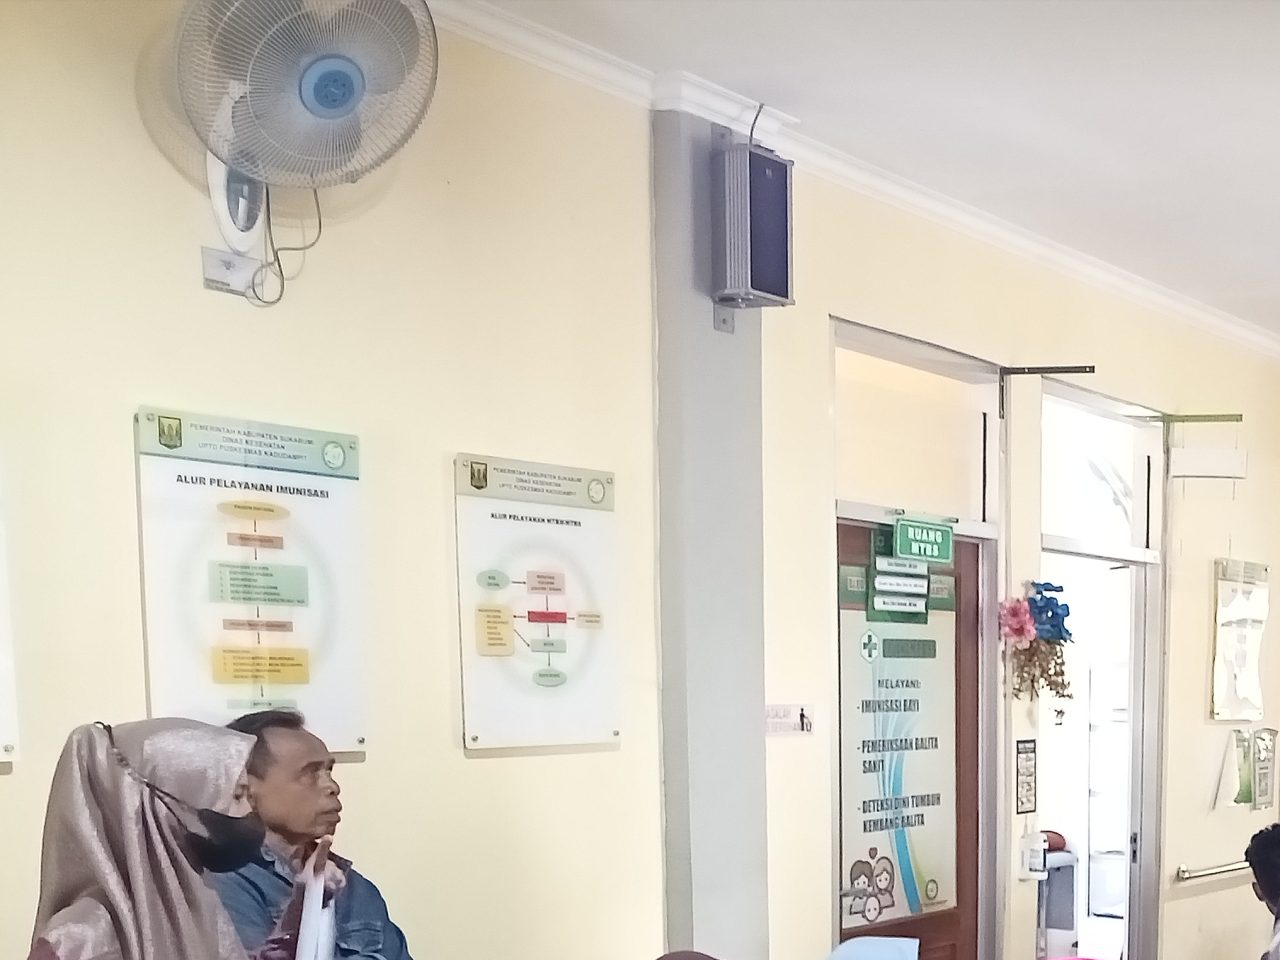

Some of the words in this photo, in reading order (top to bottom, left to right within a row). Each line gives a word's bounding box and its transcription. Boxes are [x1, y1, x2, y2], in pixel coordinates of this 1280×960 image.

[190, 423, 236, 434] PEMERINTAH
[237, 428, 279, 441] KABUPATEN
[219, 445, 263, 457] PUSKESMAS
[222, 436, 243, 445] DINAS
[244, 439, 286, 450] KESEHATAN
[176, 474, 207, 486] ALUR
[209, 477, 274, 493] PELAYANAN
[276, 485, 329, 499] IMUNISASI
[490, 512, 507, 521] ALUR
[508, 513, 546, 524] PELAYANAN
[908, 526, 943, 543] RUANG
[862, 699, 902, 713] IMUNISASI
[903, 699, 920, 712] BAYI
[862, 738, 914, 753] PEMERIKSAAN
[915, 737, 939, 751] BALITA
[862, 759, 885, 774] SAKIT
[863, 798, 893, 814] DETEKSI
[894, 796, 910, 810] DINI
[911, 793, 941, 808] TUMBUH
[863, 817, 899, 833] KEMBANG
[901, 813, 925, 828] BALITA
